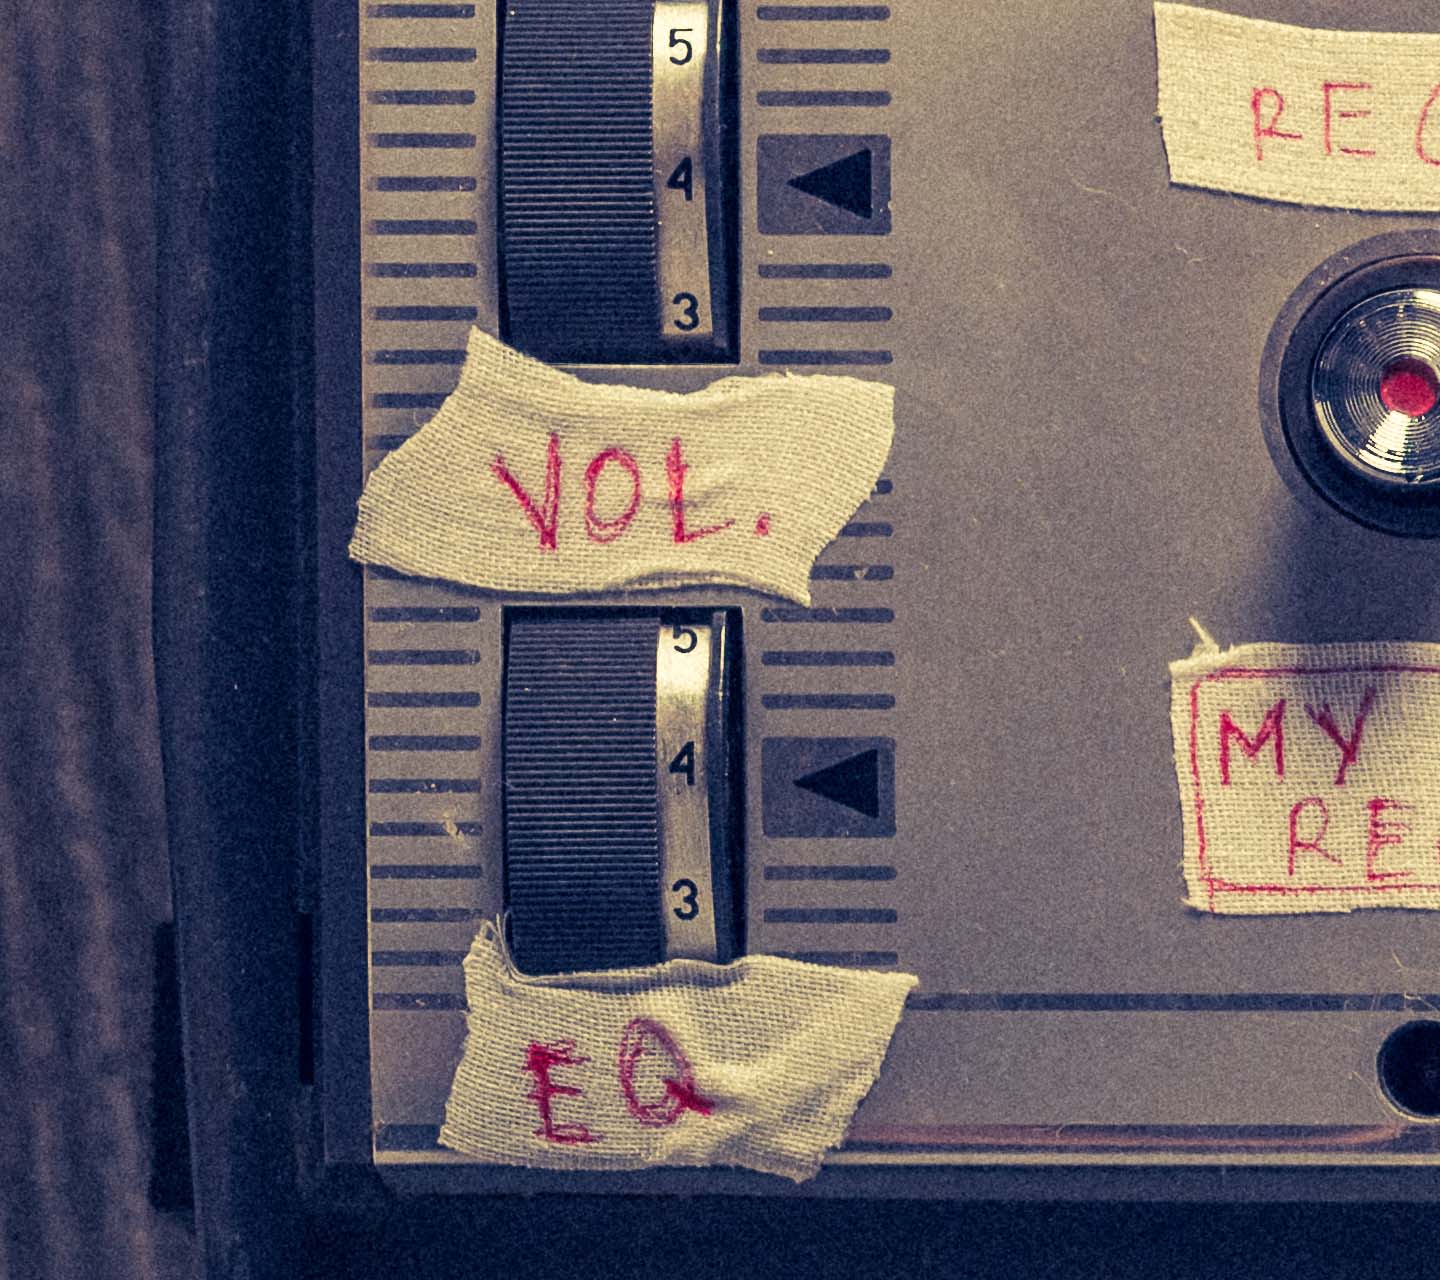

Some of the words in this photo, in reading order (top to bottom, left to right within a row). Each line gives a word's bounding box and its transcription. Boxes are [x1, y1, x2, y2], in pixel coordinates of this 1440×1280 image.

[667, 27, 695, 67] 5
[666, 156, 694, 201] 4
[671, 291, 700, 332] 3
[489, 432, 772, 553] VOL.
[1218, 686, 1376, 786] MY
[668, 740, 696, 787] 4
[670, 877, 700, 921] 3
[523, 1018, 715, 1146] EQ
